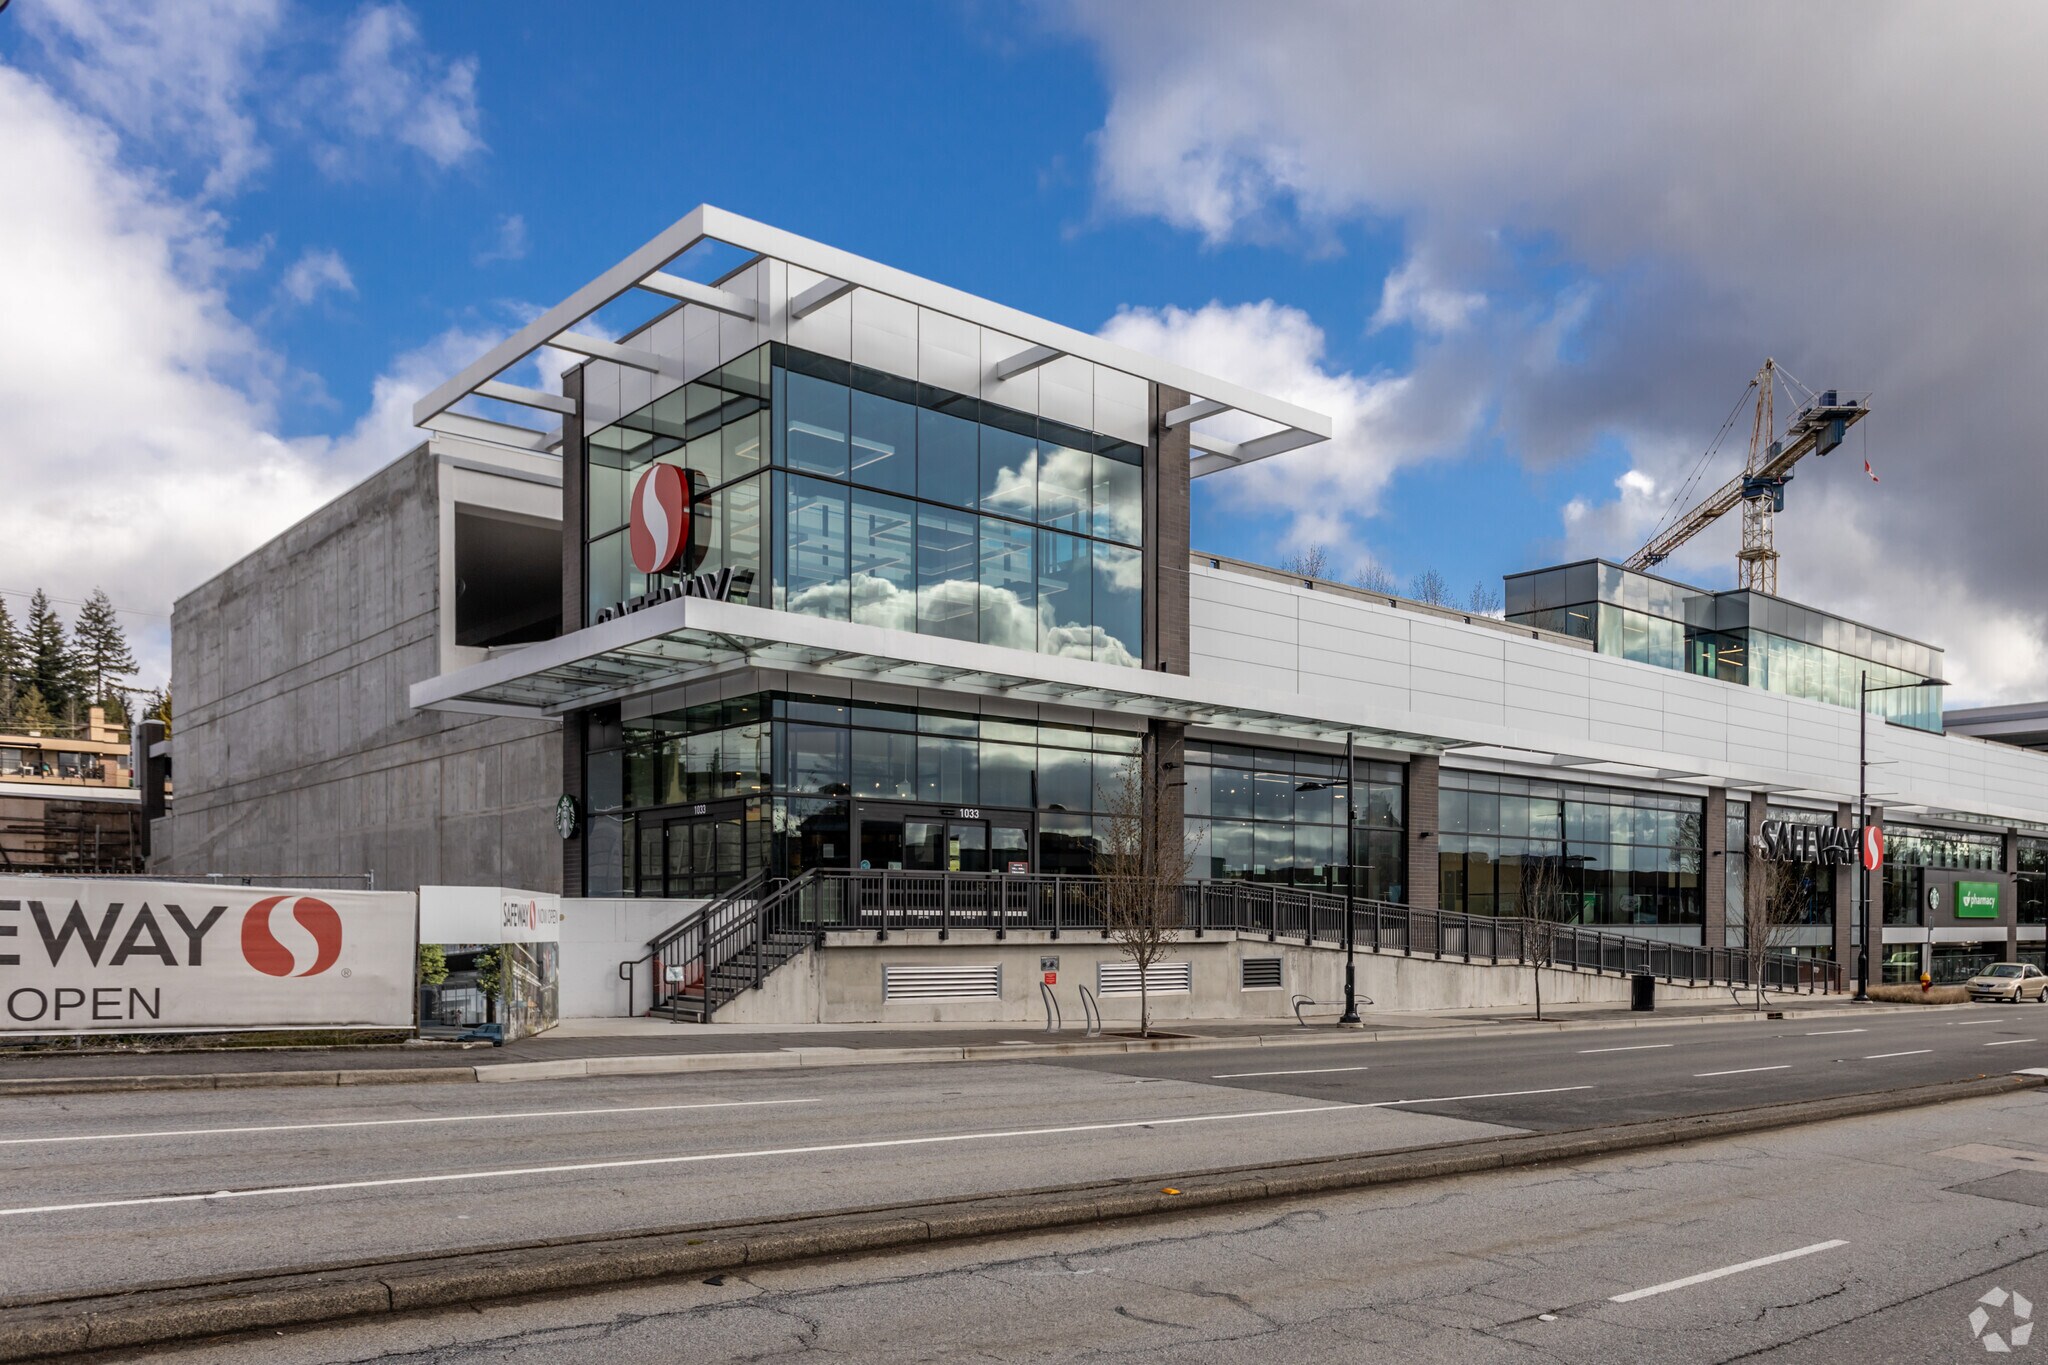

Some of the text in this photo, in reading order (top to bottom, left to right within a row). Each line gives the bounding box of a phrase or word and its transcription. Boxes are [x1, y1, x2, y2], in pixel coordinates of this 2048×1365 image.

[959, 808, 980, 819] 1033
[1970, 893, 1996, 909] pharmacy
[503, 902, 529, 927] SAFEWAY
[7, 987, 161, 1022] OPEN
